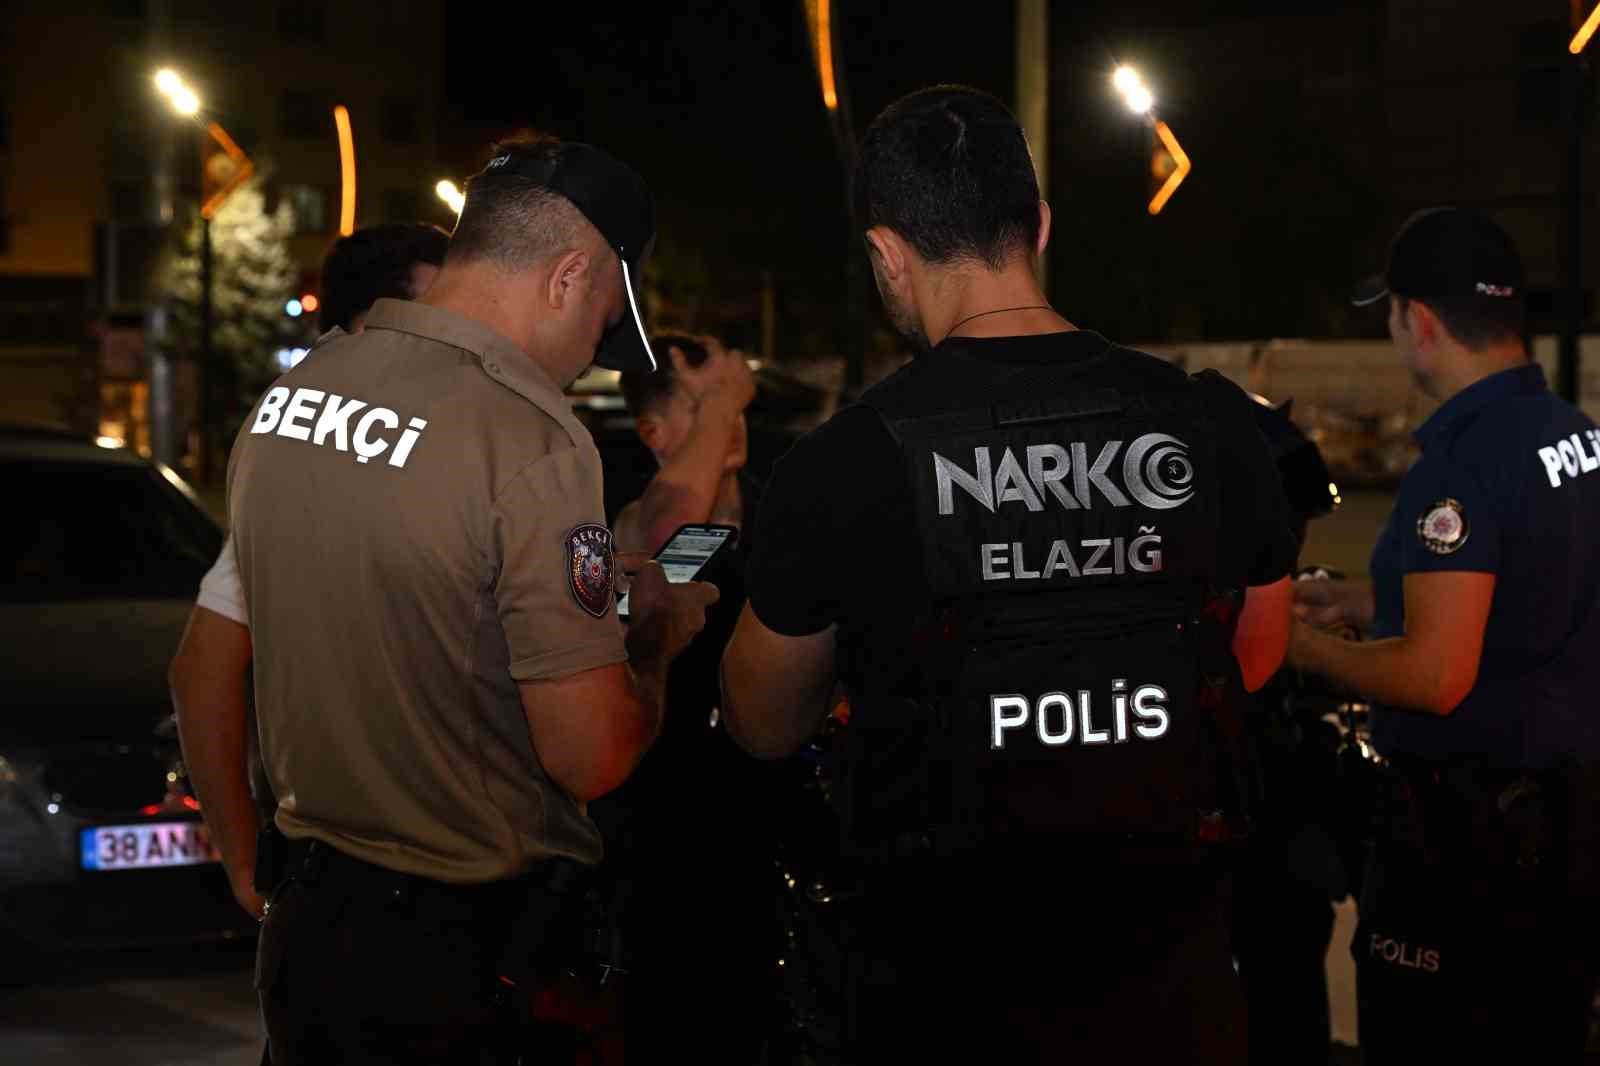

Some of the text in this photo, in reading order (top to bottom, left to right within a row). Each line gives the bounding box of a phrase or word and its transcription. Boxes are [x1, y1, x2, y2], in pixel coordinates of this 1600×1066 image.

[250, 386, 427, 468] BEKÇİ
[1537, 429, 1600, 488] POLİ
[981, 525, 1162, 580] ELAZIĞ
[990, 678, 1169, 750] POLİS
